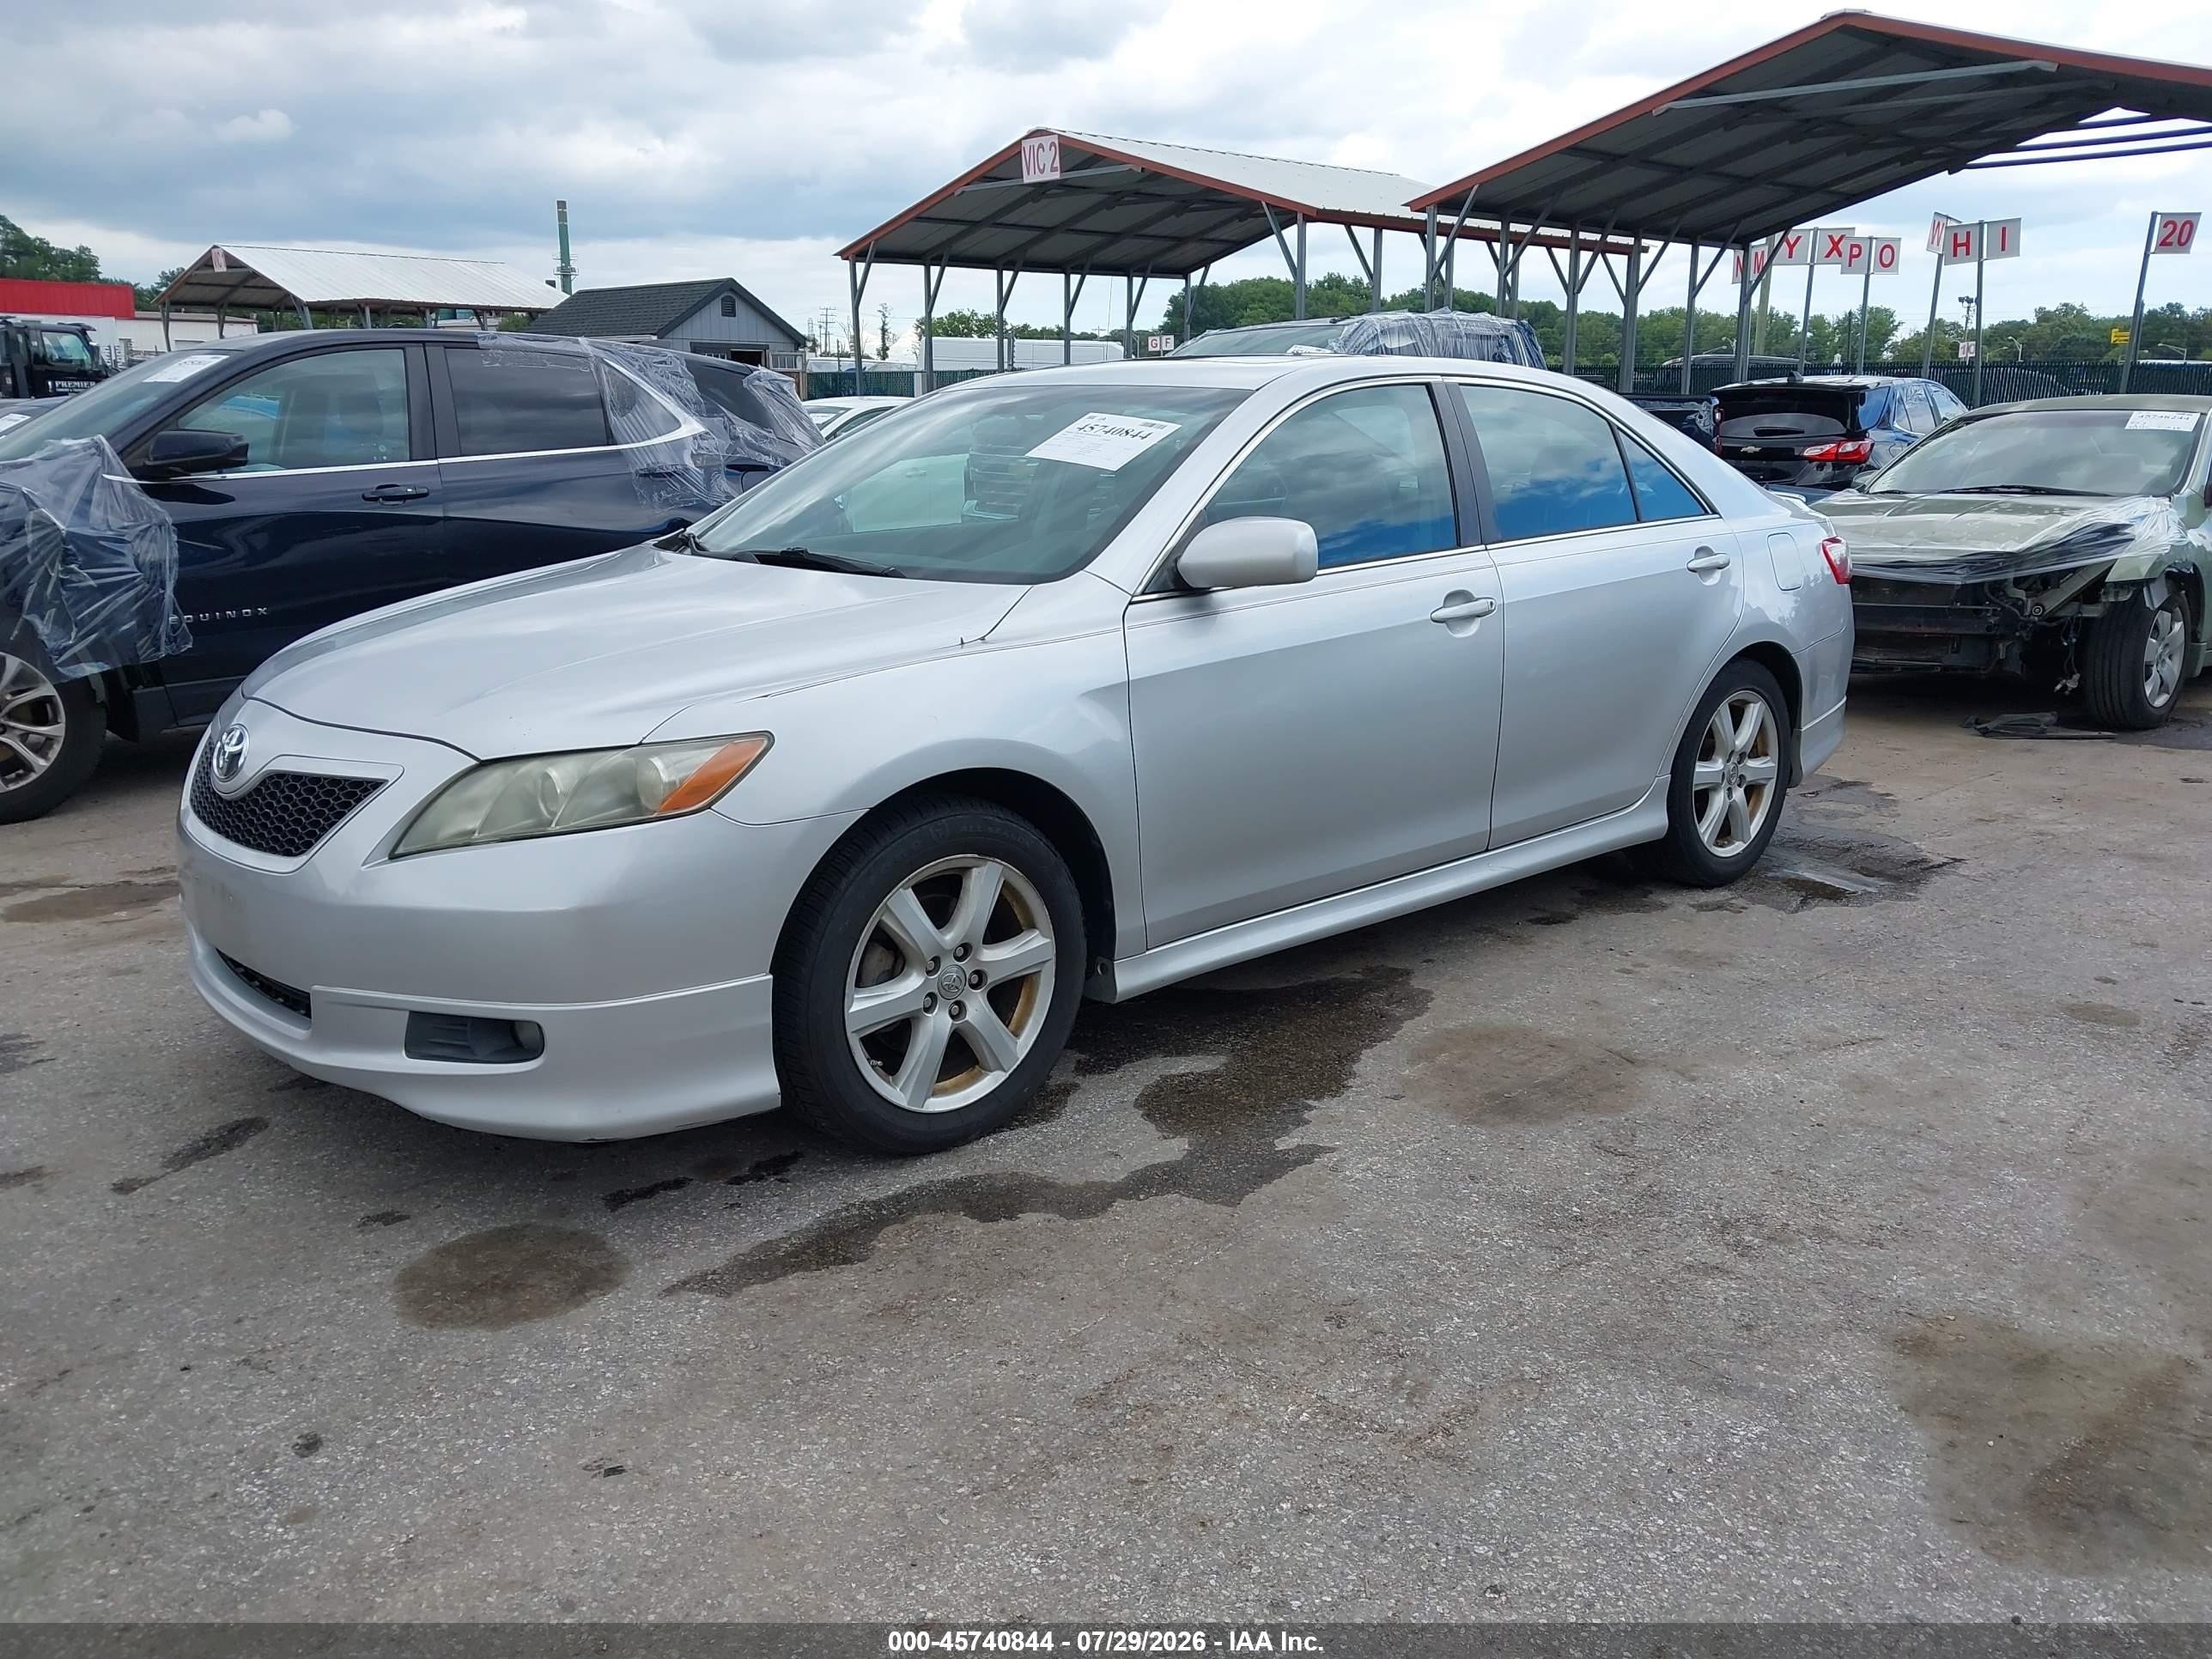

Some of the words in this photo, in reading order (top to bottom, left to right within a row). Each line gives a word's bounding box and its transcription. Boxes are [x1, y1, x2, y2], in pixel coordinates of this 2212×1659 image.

[1023, 143, 1045, 175] VIC
[1049, 141, 1058, 172] 2
[1931, 220, 1945, 246] W
[1953, 231, 1971, 258] H
[2001, 226, 2007, 252] I
[2159, 220, 2194, 246] 20
[1784, 235, 1802, 259] Y
[1824, 234, 1846, 258] X
[1848, 243, 1862, 268] P
[1879, 243, 1895, 269] O
[1753, 250, 1765, 275] M
[1151, 338, 1158, 349] G
[1165, 337, 1170, 348] F
[1077, 422, 1153, 441] 45740844
[168, 607, 268, 624] EQUINOX
